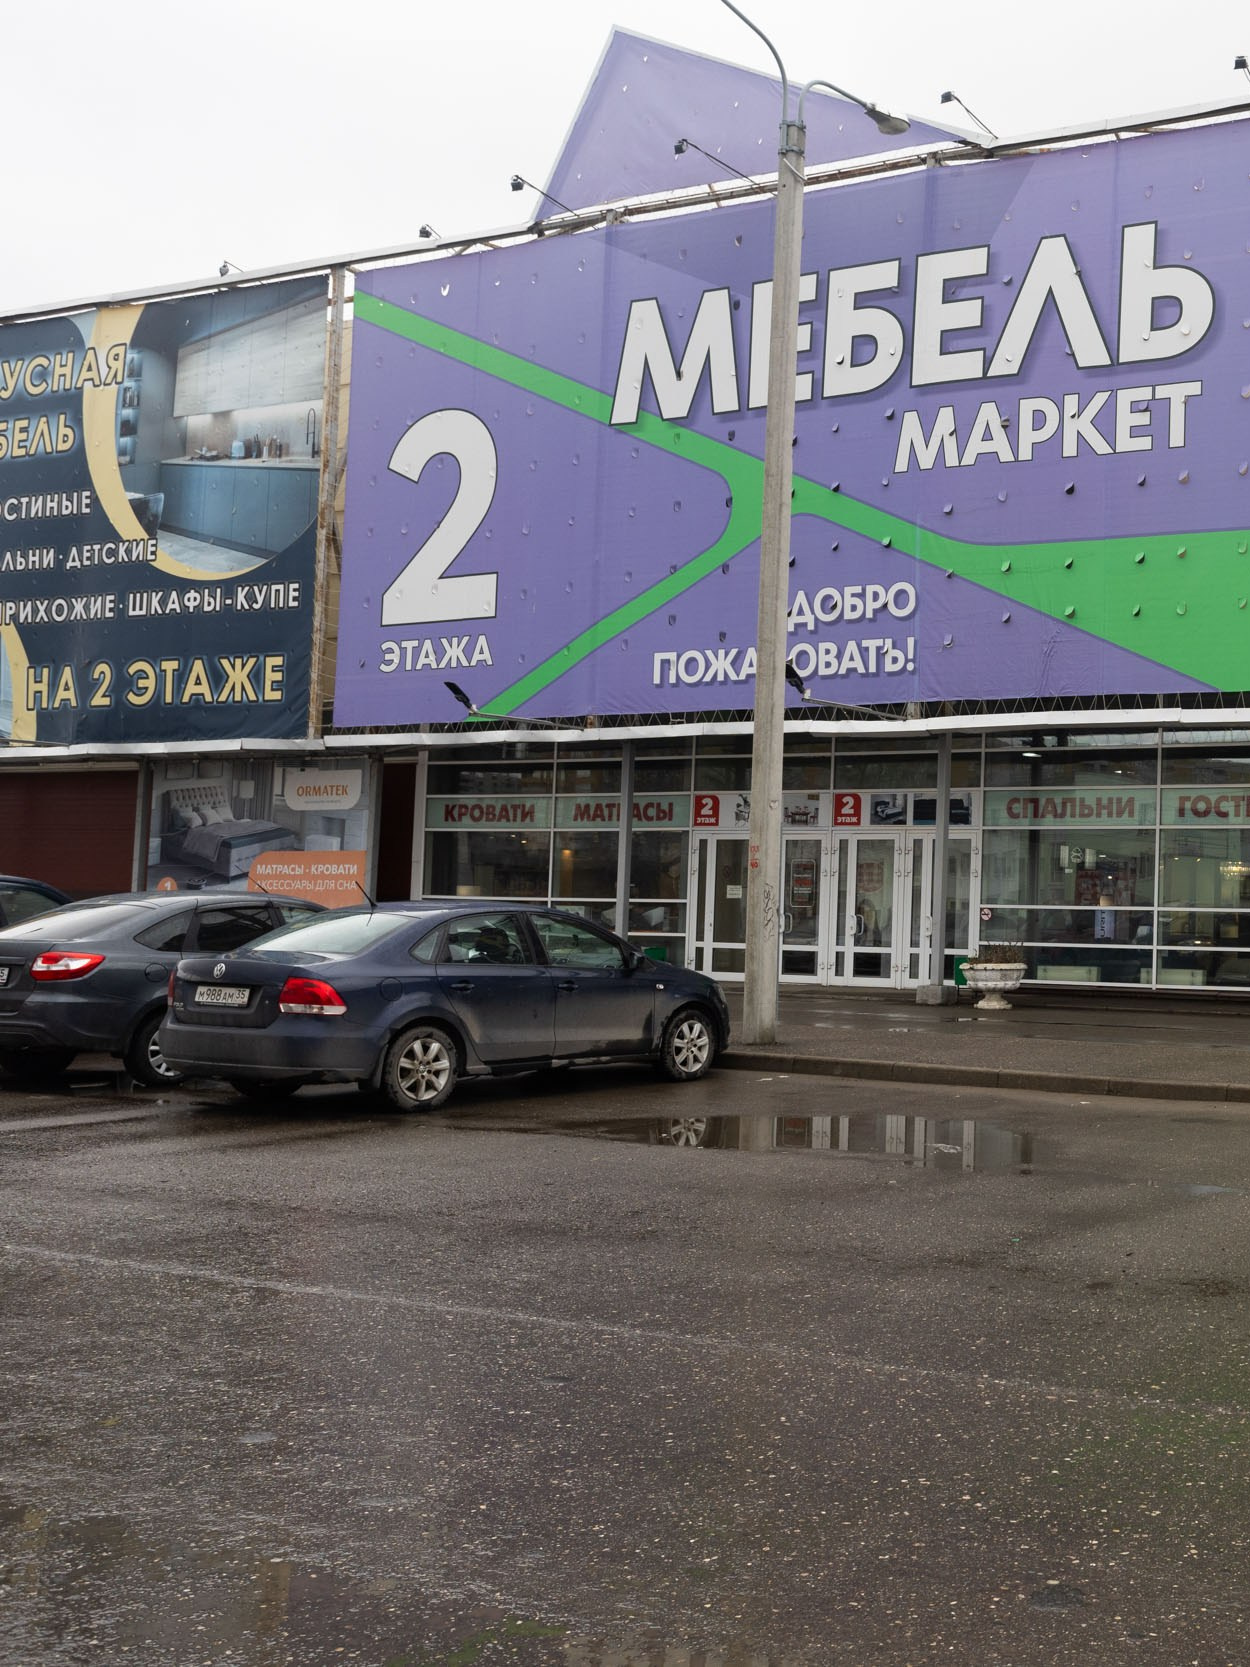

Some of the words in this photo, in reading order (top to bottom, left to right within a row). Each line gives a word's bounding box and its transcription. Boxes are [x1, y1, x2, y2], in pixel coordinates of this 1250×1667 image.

[609, 221, 1215, 425] МЕБЕЛЬ
[893, 380, 1203, 473] МАРКЕТ
[0, 490, 91, 521] СТИНЫЕ
[380, 408, 498, 627] 2
[66, 538, 158, 571] ДЕТСКИЕ
[128, 583, 301, 617] ШКАФЫ-КУПЕ
[787, 581, 916, 632] ДОБРО
[378, 634, 494, 673] ЭТАЖА
[652, 636, 915, 685] ПОЖАОВАТЬ!
[26, 665, 79, 711] НА
[89, 661, 113, 707] 2
[125, 655, 285, 707] ЭТАЖЕ
[296, 784, 349, 797] ORMATEK
[701, 797, 714, 815] 2
[841, 796, 855, 814] 2
[444, 803, 536, 823] КРОВАТИ
[573, 802, 674, 822] МАТАСЫ
[1005, 796, 1135, 820] СПАЛЬНИ
[255, 880, 314, 891] АКСЕССУАРЫ
[316, 880, 335, 891] ДЛЯ
[337, 880, 358, 891] СНА
[256, 864, 304, 875] МАТРАСЫ
[311, 864, 358, 875] КРОВАТИ
